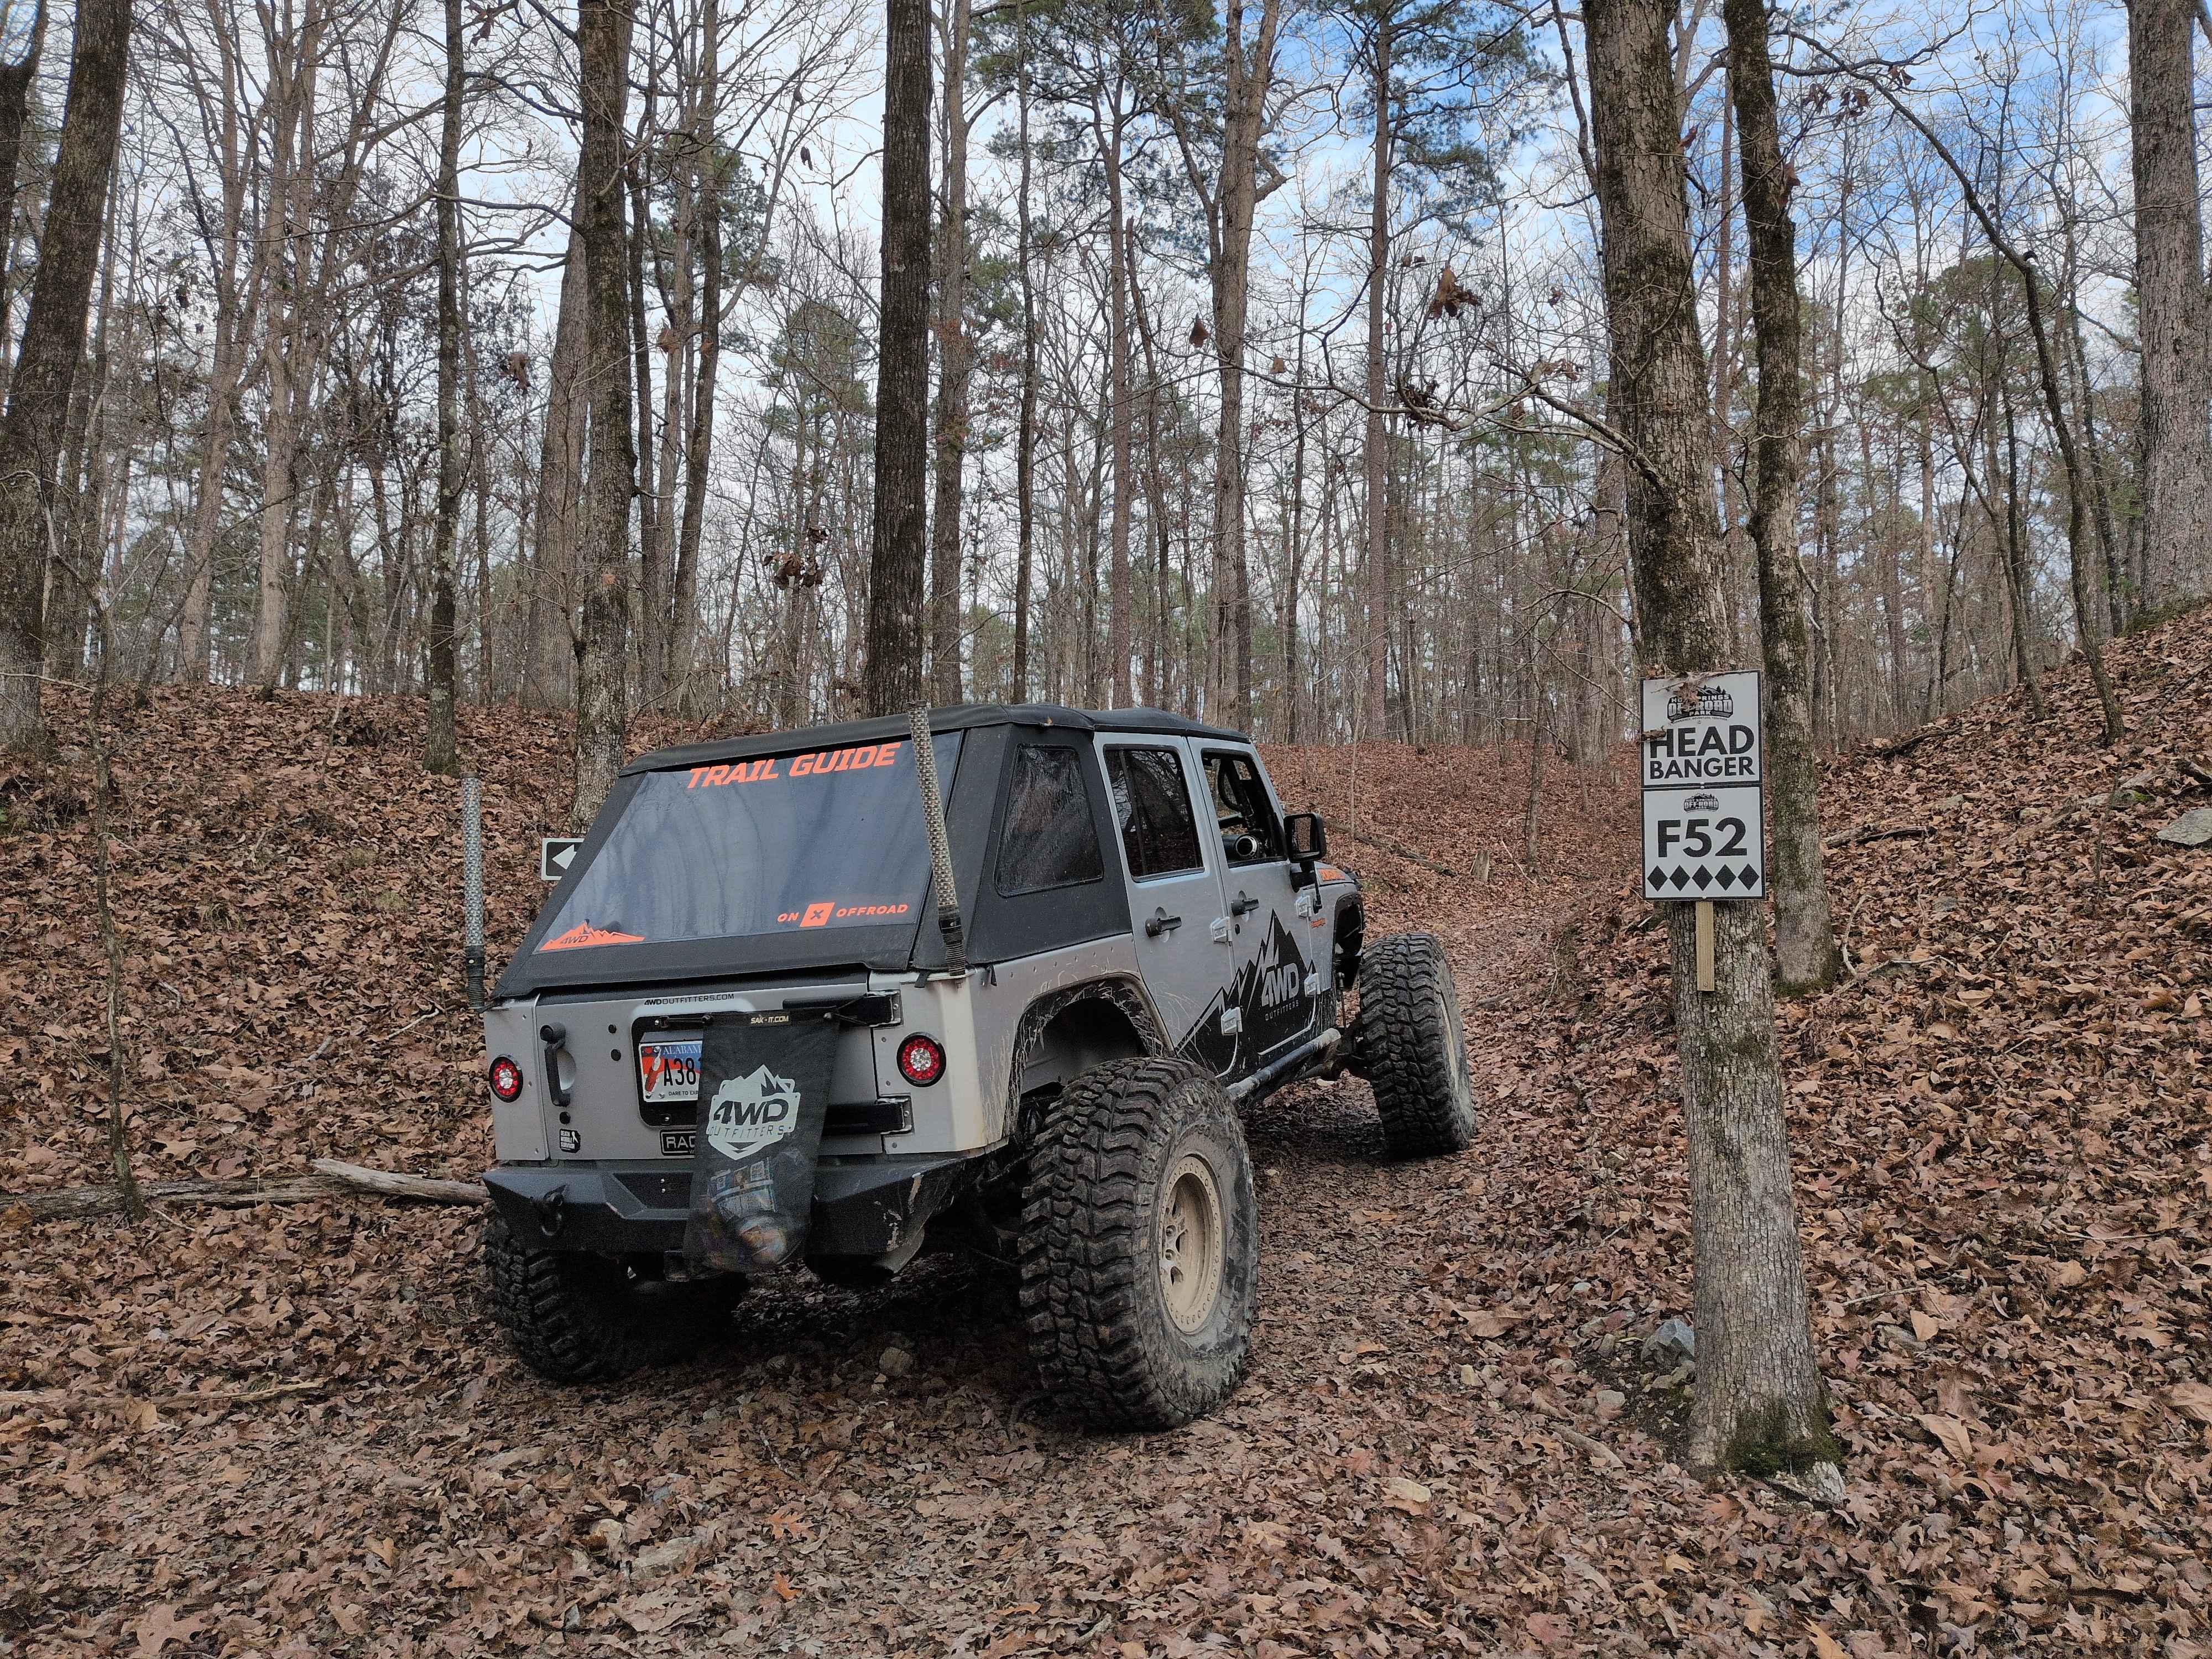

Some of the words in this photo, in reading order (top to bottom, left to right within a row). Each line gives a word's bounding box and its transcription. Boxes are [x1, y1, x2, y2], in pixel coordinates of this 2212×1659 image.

[1650, 724, 1755, 758] HEAD
[687, 759, 779, 789] TRAIL
[789, 743, 901, 777] GUIDE
[1650, 756, 1755, 780] BANGER
[1657, 817, 1747, 858] F52
[777, 912, 799, 923] ON
[836, 904, 909, 917] OFFROAD
[560, 935, 589, 945] 4WD
[1261, 963, 1299, 1007] 4WD
[644, 993, 734, 1005] 4WDOUTFITTERS.COM
[1265, 999, 1299, 1021] OUTFITTERS
[663, 1045, 701, 1055] ALABAM
[664, 1057, 702, 1086] A38
[713, 1098, 789, 1125] 4WD
[666, 1135, 696, 1149] RAC
[708, 1125, 785, 1138] OUTFITTERS
